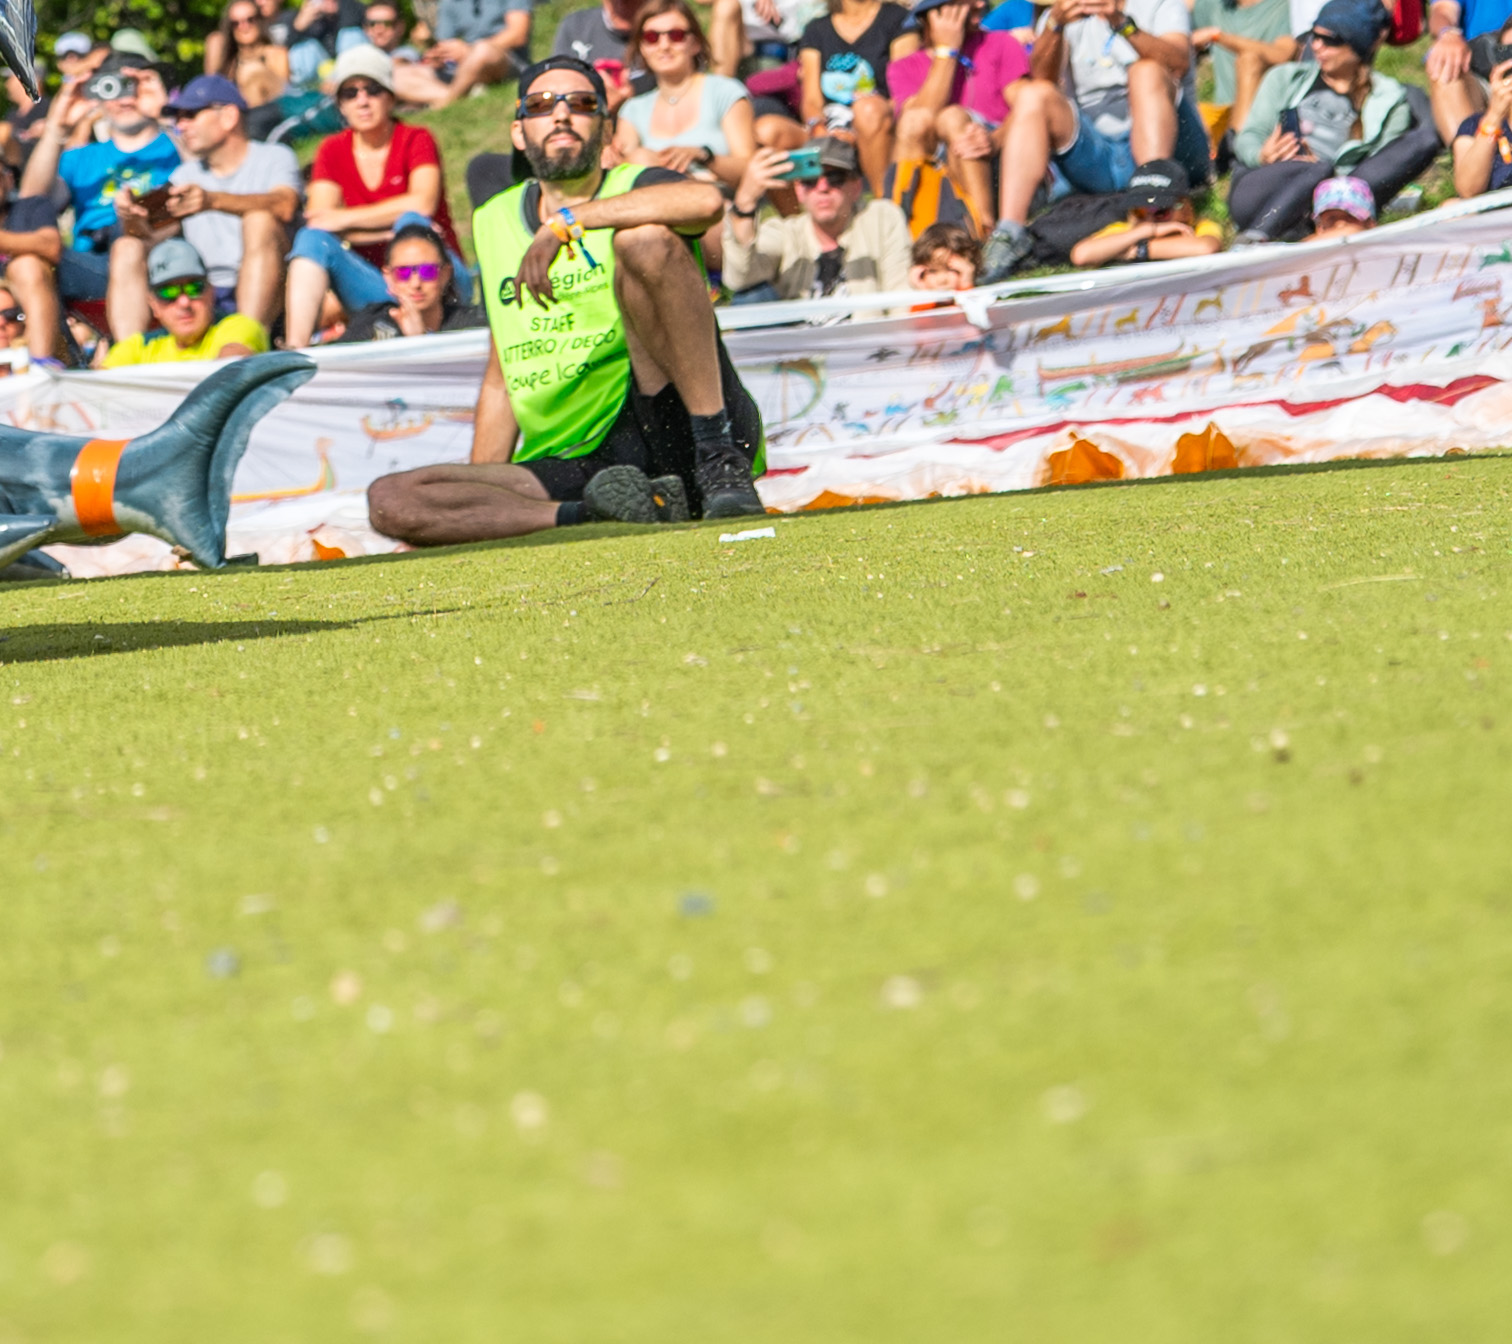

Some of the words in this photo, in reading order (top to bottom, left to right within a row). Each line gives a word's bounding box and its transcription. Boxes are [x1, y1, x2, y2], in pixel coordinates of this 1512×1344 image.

[551, 262, 606, 290] égion
[530, 313, 575, 332] STAFF
[507, 369, 551, 393] oupe
[556, 361, 590, 382] Ica
